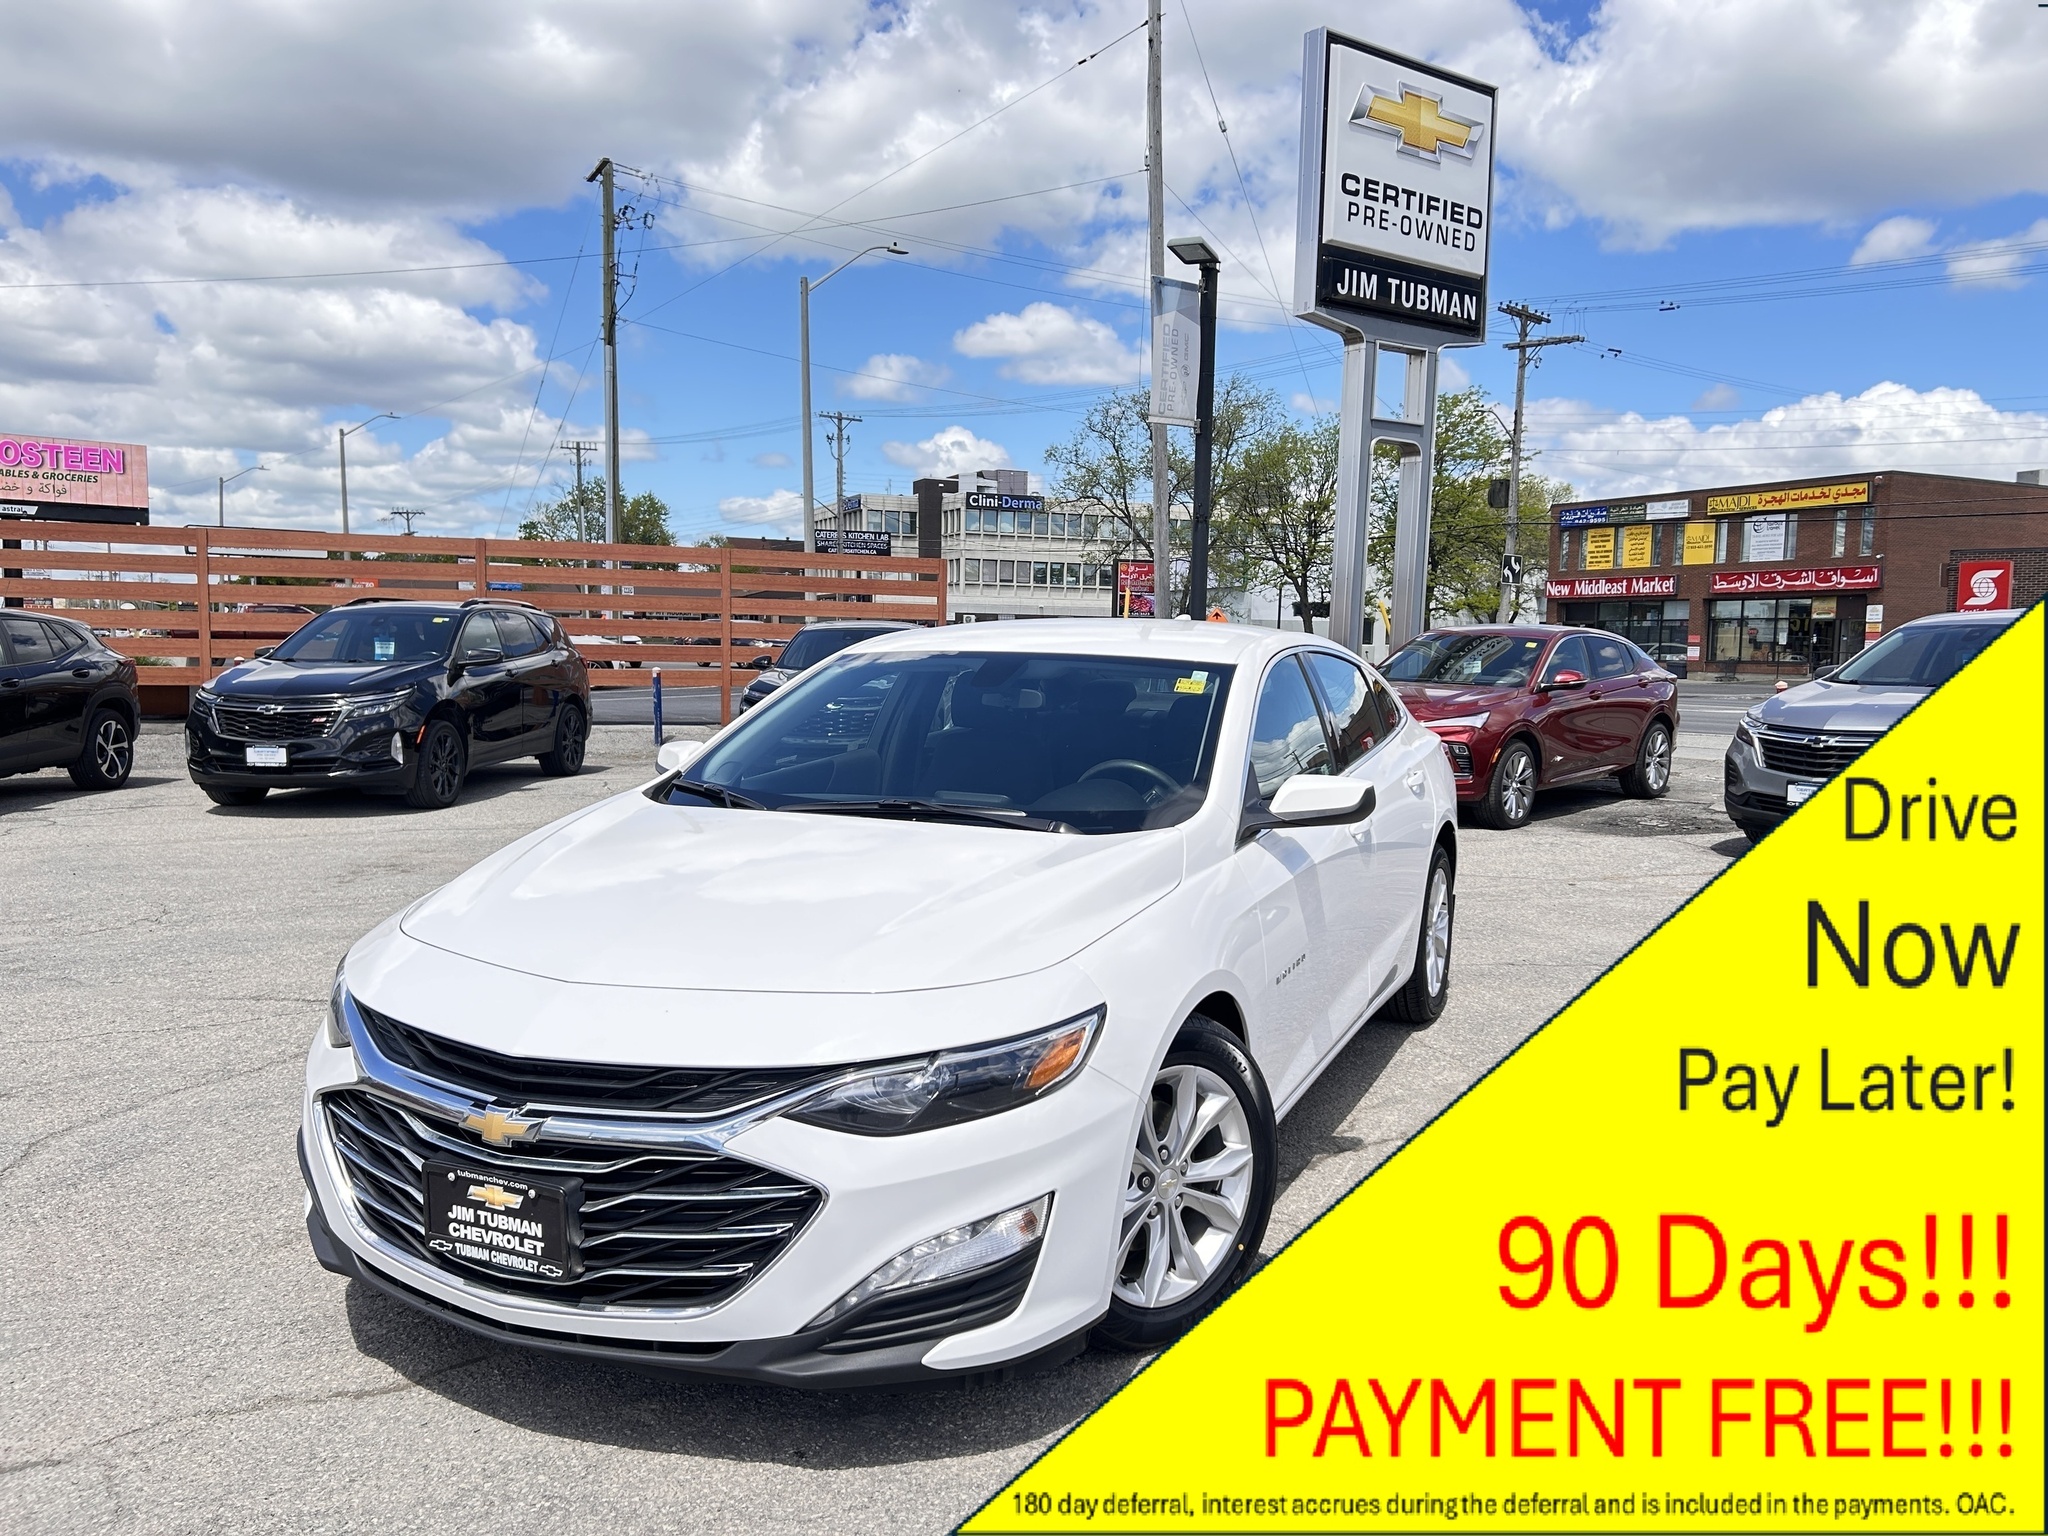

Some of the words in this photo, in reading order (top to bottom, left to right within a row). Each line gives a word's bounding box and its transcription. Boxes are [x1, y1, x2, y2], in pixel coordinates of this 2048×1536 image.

[1340, 172, 1484, 230] CERTIFIED
[1347, 201, 1477, 252] PRE-OWNED
[1337, 268, 1379, 301] JIM
[1388, 277, 1478, 321] TUBMAN
[1158, 323, 1171, 415] CERTIFIED
[1167, 328, 1179, 412] PRE-OWNED
[31, 471, 40, 479] &
[41, 471, 98, 483] GROCERIES
[969, 494, 1043, 509] Clini-Derma
[1718, 496, 1751, 510] MAJDI
[848, 532, 874, 541] KITCHEN
[1546, 581, 1571, 596] New
[1574, 579, 1627, 595] Middleast
[1631, 576, 1674, 593] Market
[457, 1169, 528, 1191] tubmanchev.com
[448, 1205, 474, 1223] JIM
[477, 1210, 542, 1238] TUBMAN
[449, 1223, 544, 1256] CHEVROLET
[455, 1243, 490, 1262] TUBMAN
[490, 1251, 538, 1273] CHEVROLET
